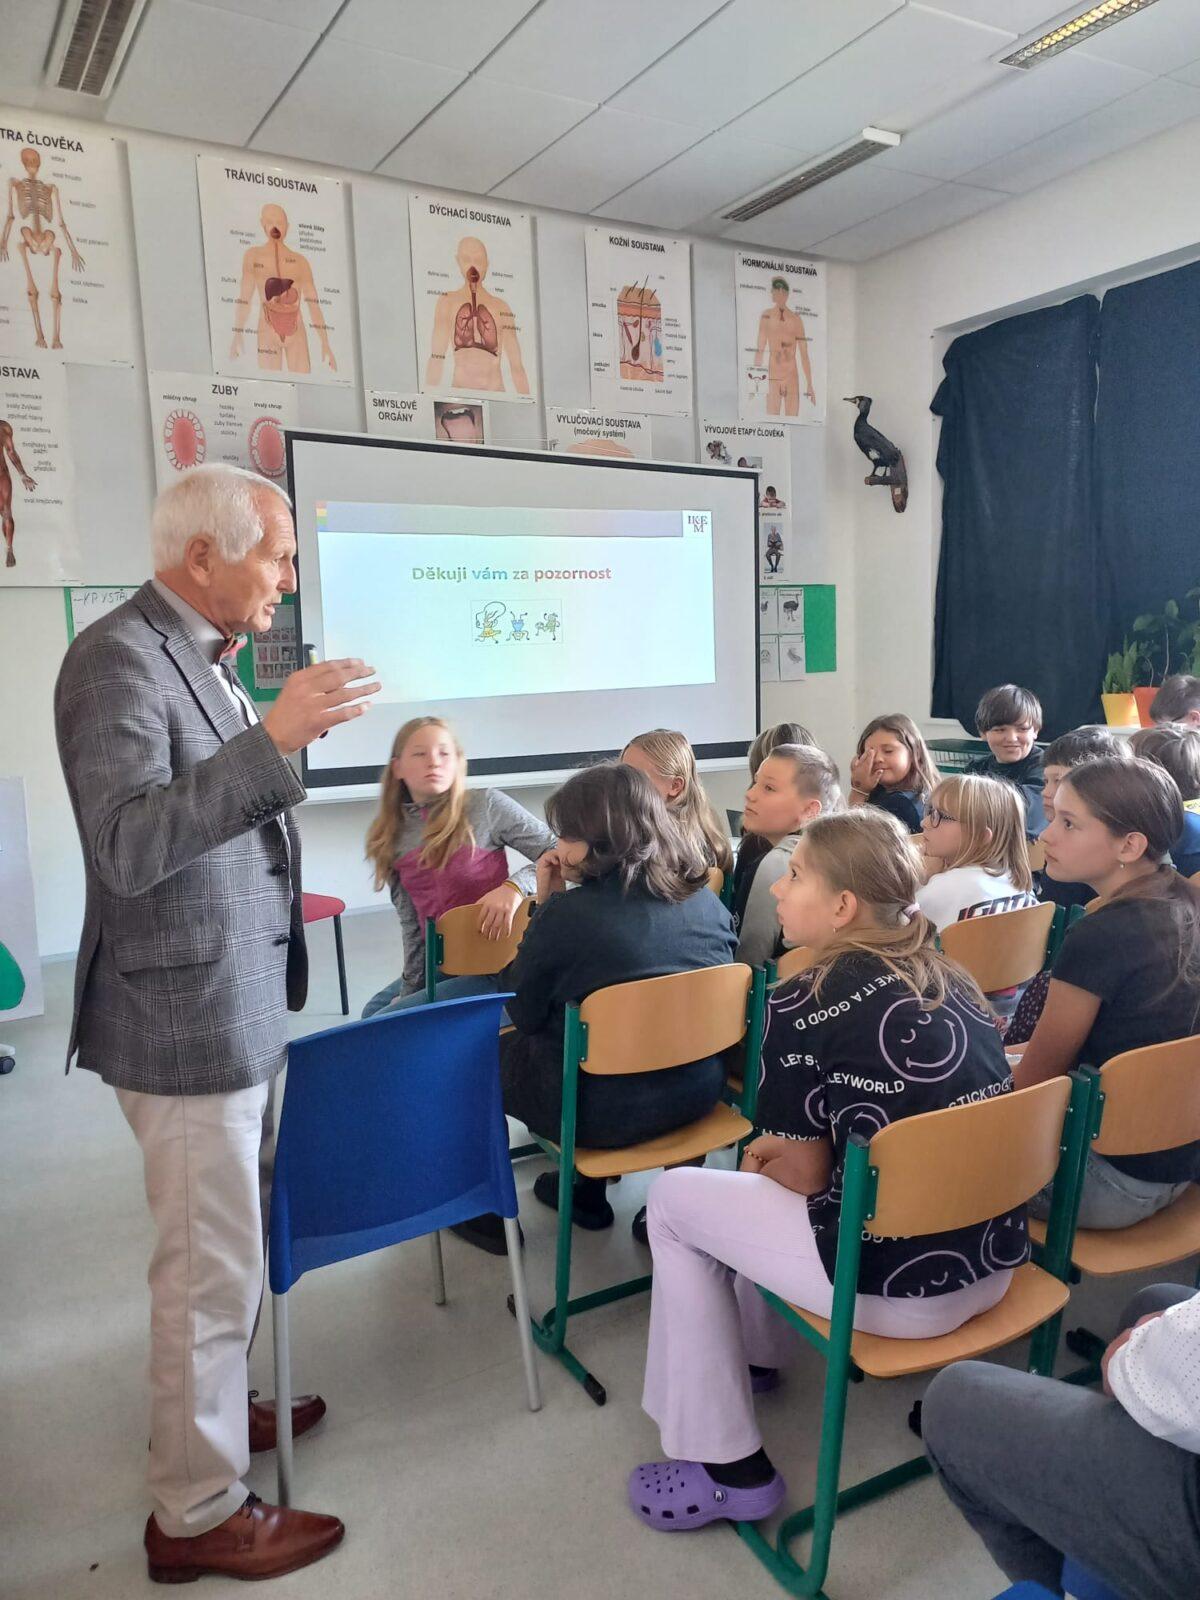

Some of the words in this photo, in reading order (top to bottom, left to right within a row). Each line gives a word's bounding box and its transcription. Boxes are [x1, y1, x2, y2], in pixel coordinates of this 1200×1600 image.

[26, 131, 84, 153] ČLOVĚKA
[225, 168, 265, 185] TRÁVICÍ
[267, 176, 318, 194] SOUSTAVA
[429, 203, 468, 219] DÝCHACÍ
[469, 211, 512, 227] SOUSTAVA
[609, 235, 630, 247] KOŽNÍ
[631, 240, 666, 253] SOUSTAVA
[742, 257, 785, 271] HORMONÁLNÍ
[785, 264, 818, 276] SOUSTAVA
[0, 366, 40, 380] STAVA
[211, 384, 239, 396] ZUBY
[372, 398, 418, 410] SMYSLOVÉ
[378, 411, 413, 422] ORGÁNY
[556, 413, 604, 426] VYLUČOVACÍ
[605, 418, 641, 429] SOUSTAVA
[704, 424, 737, 435] VÝVOJOVÉ
[737, 427, 756, 436] ETAPY
[757, 427, 785, 438] ČLOVĚKA
[412, 566, 467, 583] Děkuji
[471, 567, 508, 580] vám
[512, 570, 529, 580] za
[534, 568, 612, 583] pozornost
[849, 991, 863, 1003] A
[808, 1000, 851, 1026] GOOD
